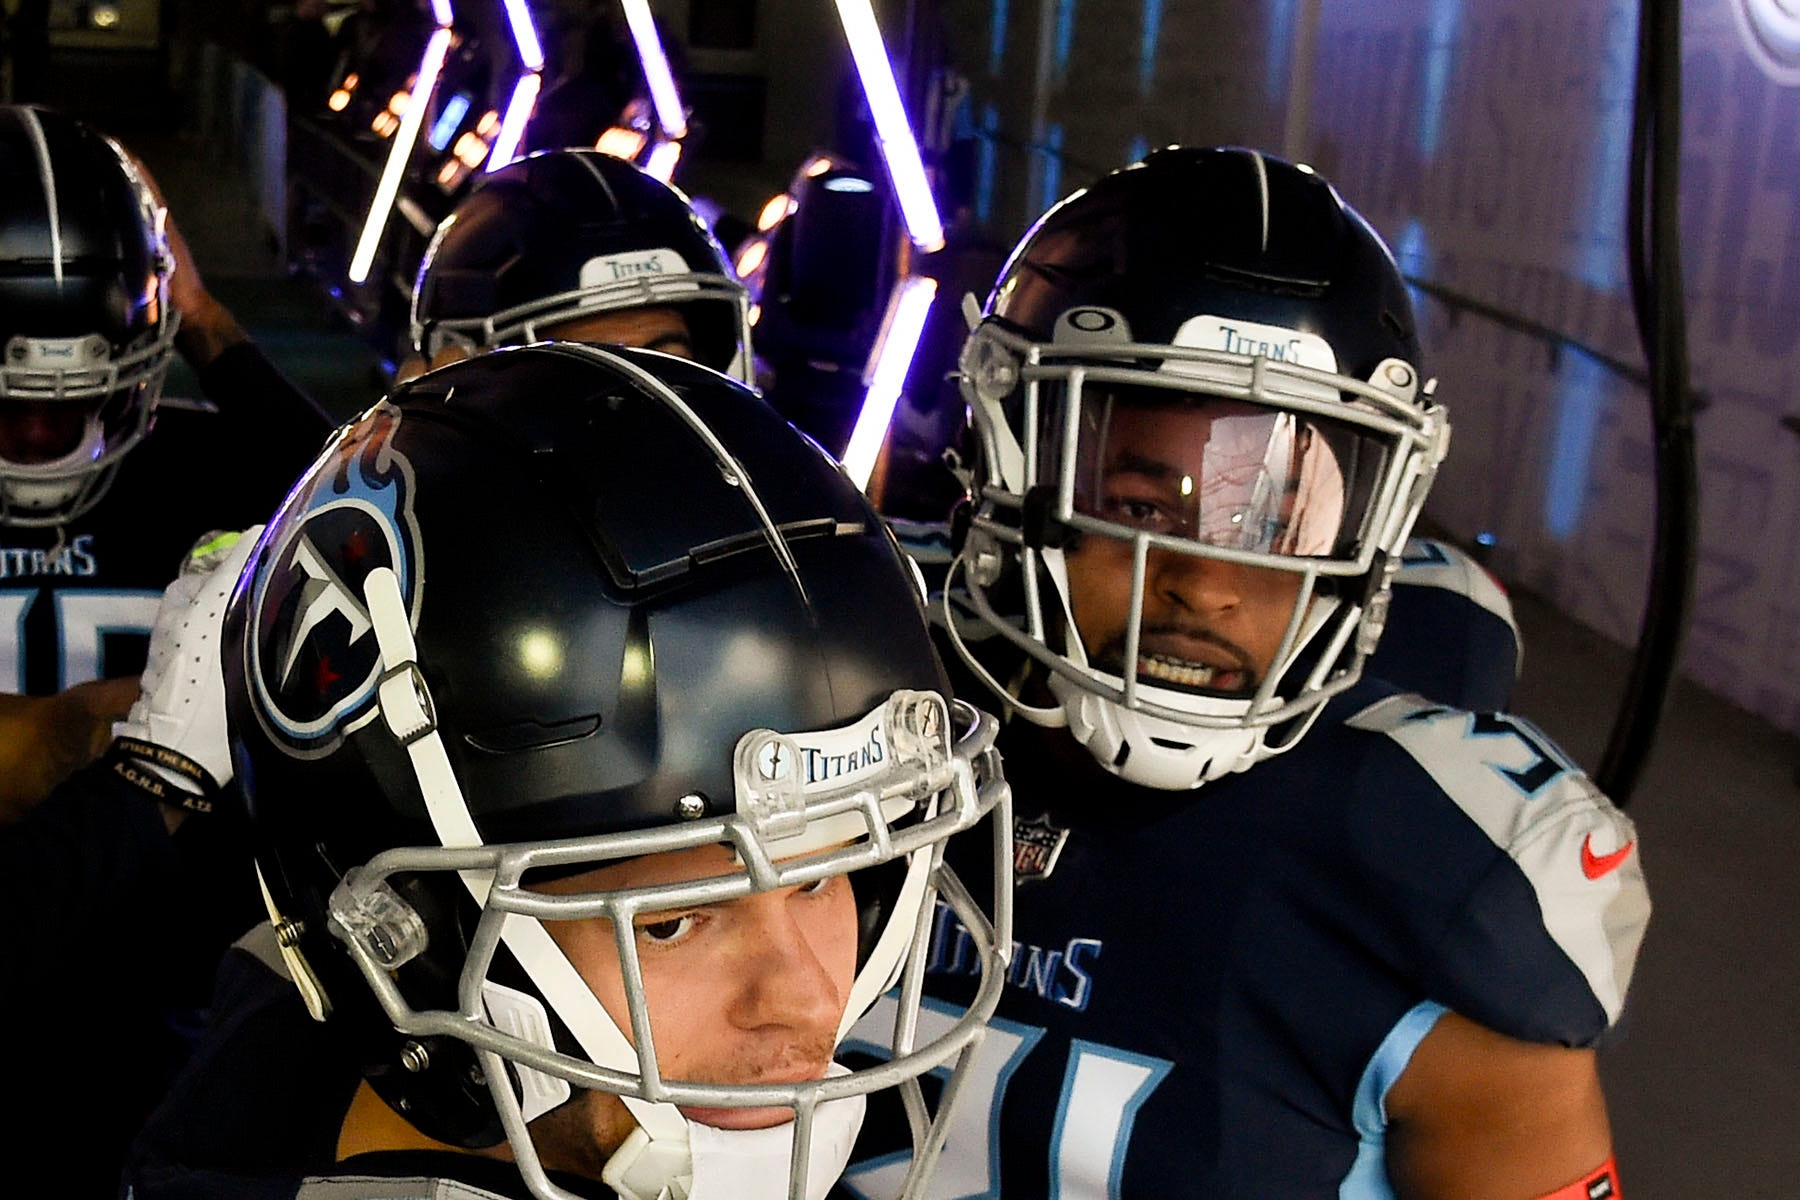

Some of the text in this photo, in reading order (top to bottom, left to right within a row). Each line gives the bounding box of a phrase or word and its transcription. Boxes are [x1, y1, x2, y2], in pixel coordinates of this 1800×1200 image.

[1219, 326, 1302, 364] TITANS
[800, 724, 884, 785] TITANS
[926, 899, 1104, 1012] TINS
